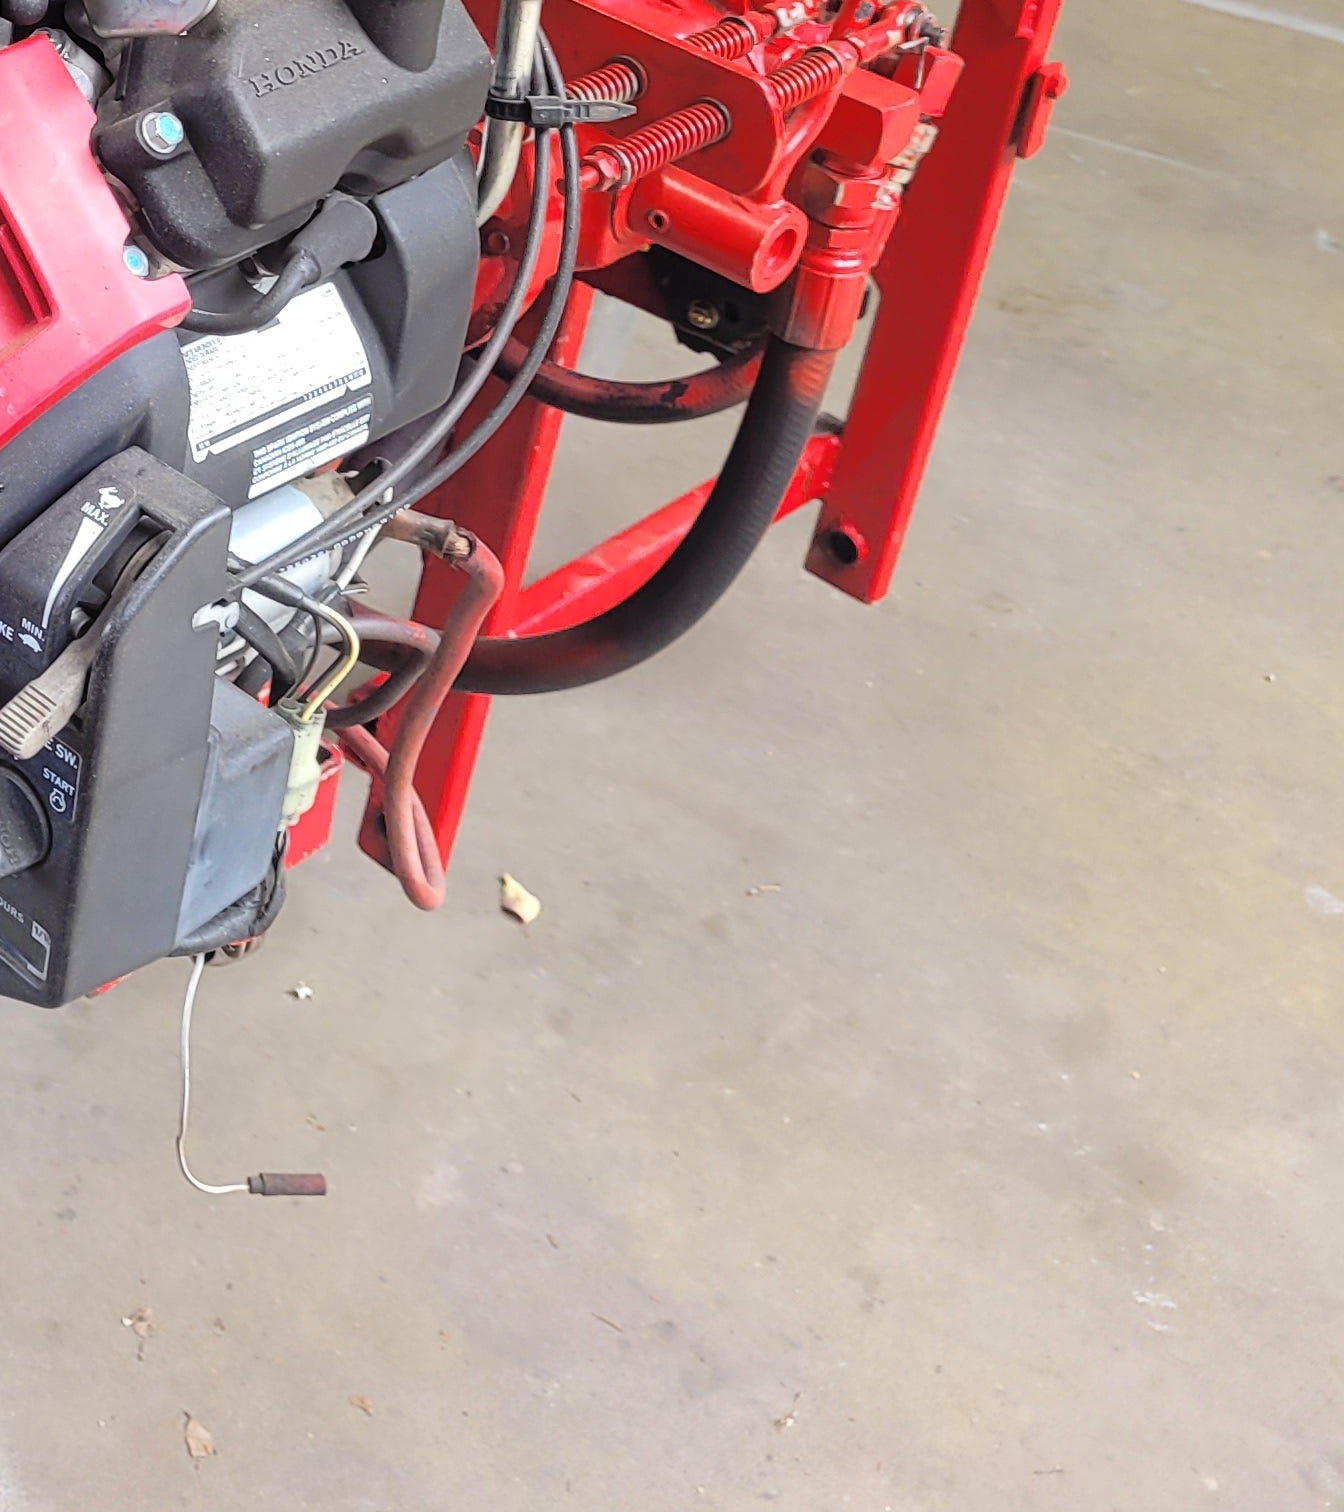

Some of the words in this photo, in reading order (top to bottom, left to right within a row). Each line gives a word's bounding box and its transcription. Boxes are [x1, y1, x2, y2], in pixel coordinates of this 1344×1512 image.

[248, 40, 366, 98] HONDA
[80, 501, 110, 527] MAX.
[21, 617, 45, 642] MIN.
[54, 742, 78, 770] SW.
[42, 767, 76, 797] START
